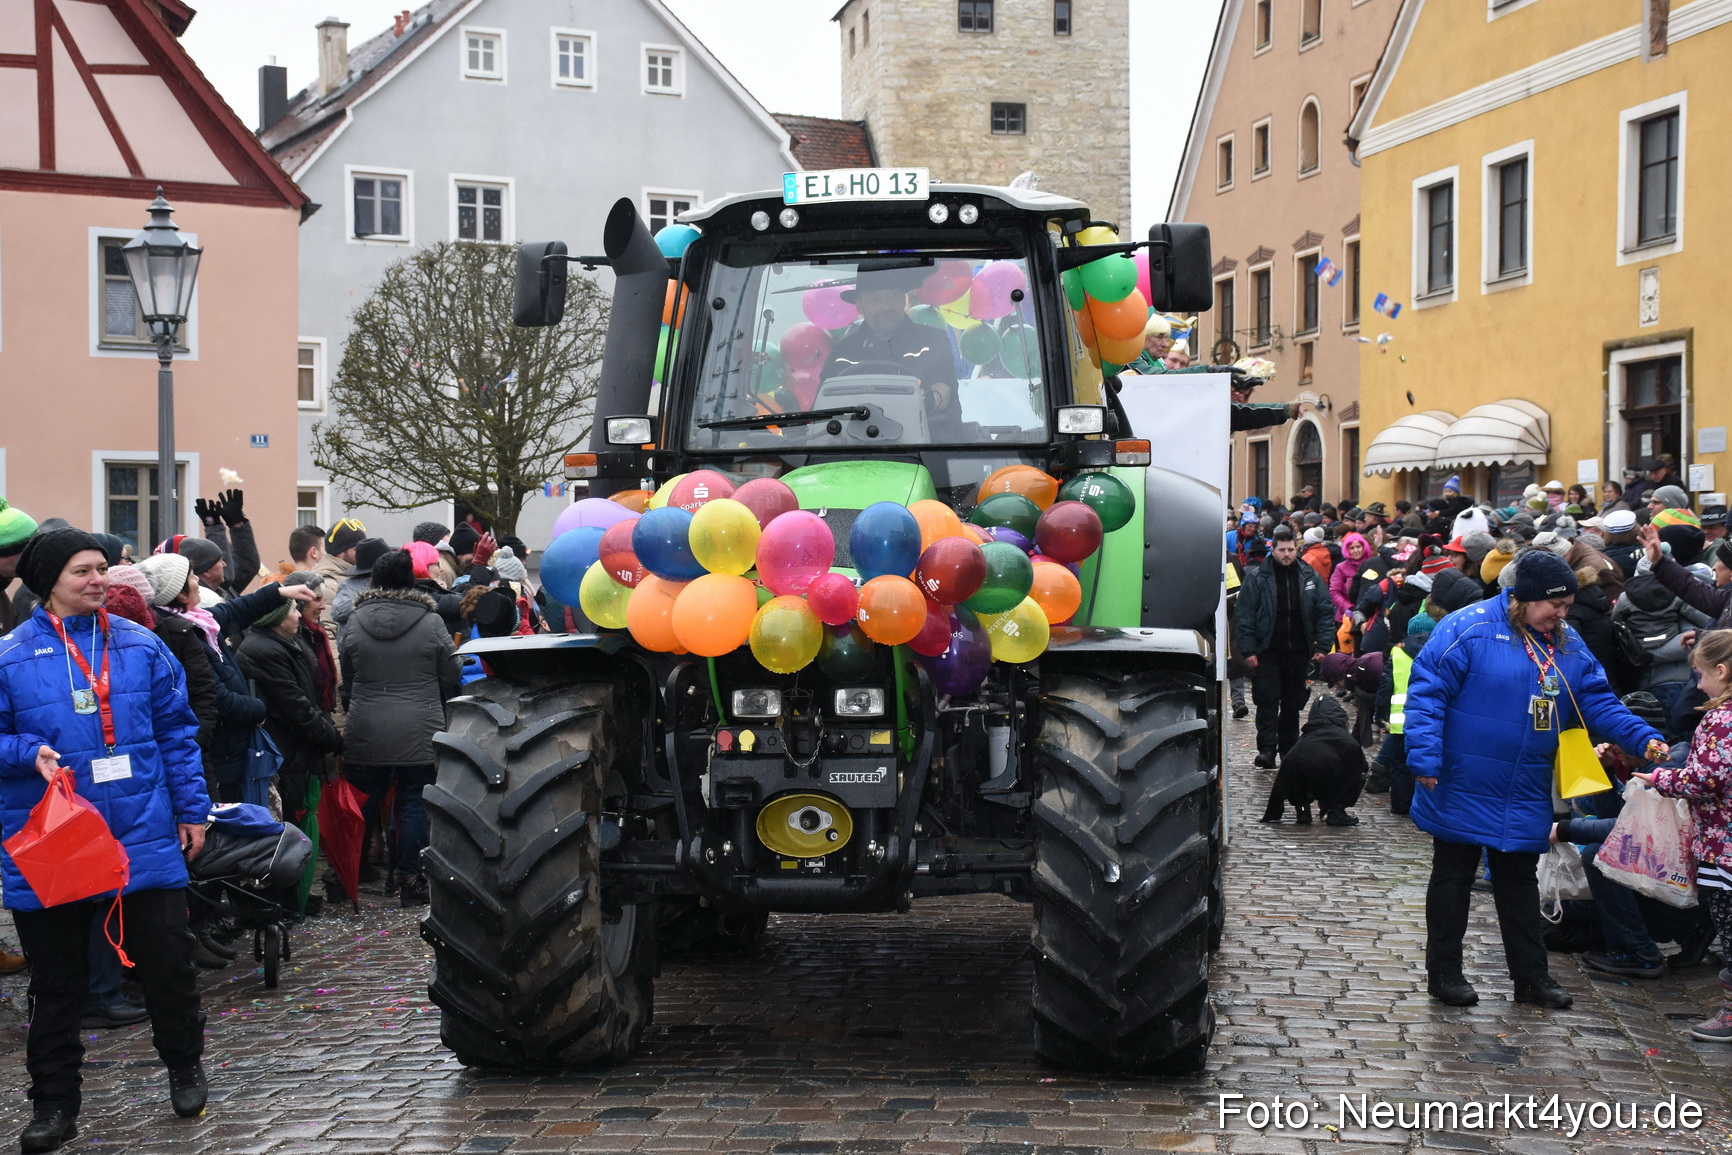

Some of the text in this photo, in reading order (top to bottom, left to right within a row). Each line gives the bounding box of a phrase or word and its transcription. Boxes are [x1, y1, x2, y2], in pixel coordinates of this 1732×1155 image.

[805, 173, 918, 198] EI HO 13
[788, 191, 794, 199] D
[256, 435, 265, 444] 11
[1495, 633, 1510, 641] JAKO
[34, 646, 54, 656] JAKO
[829, 772, 881, 784] SAUTER
[1670, 872, 1688, 884] dm
